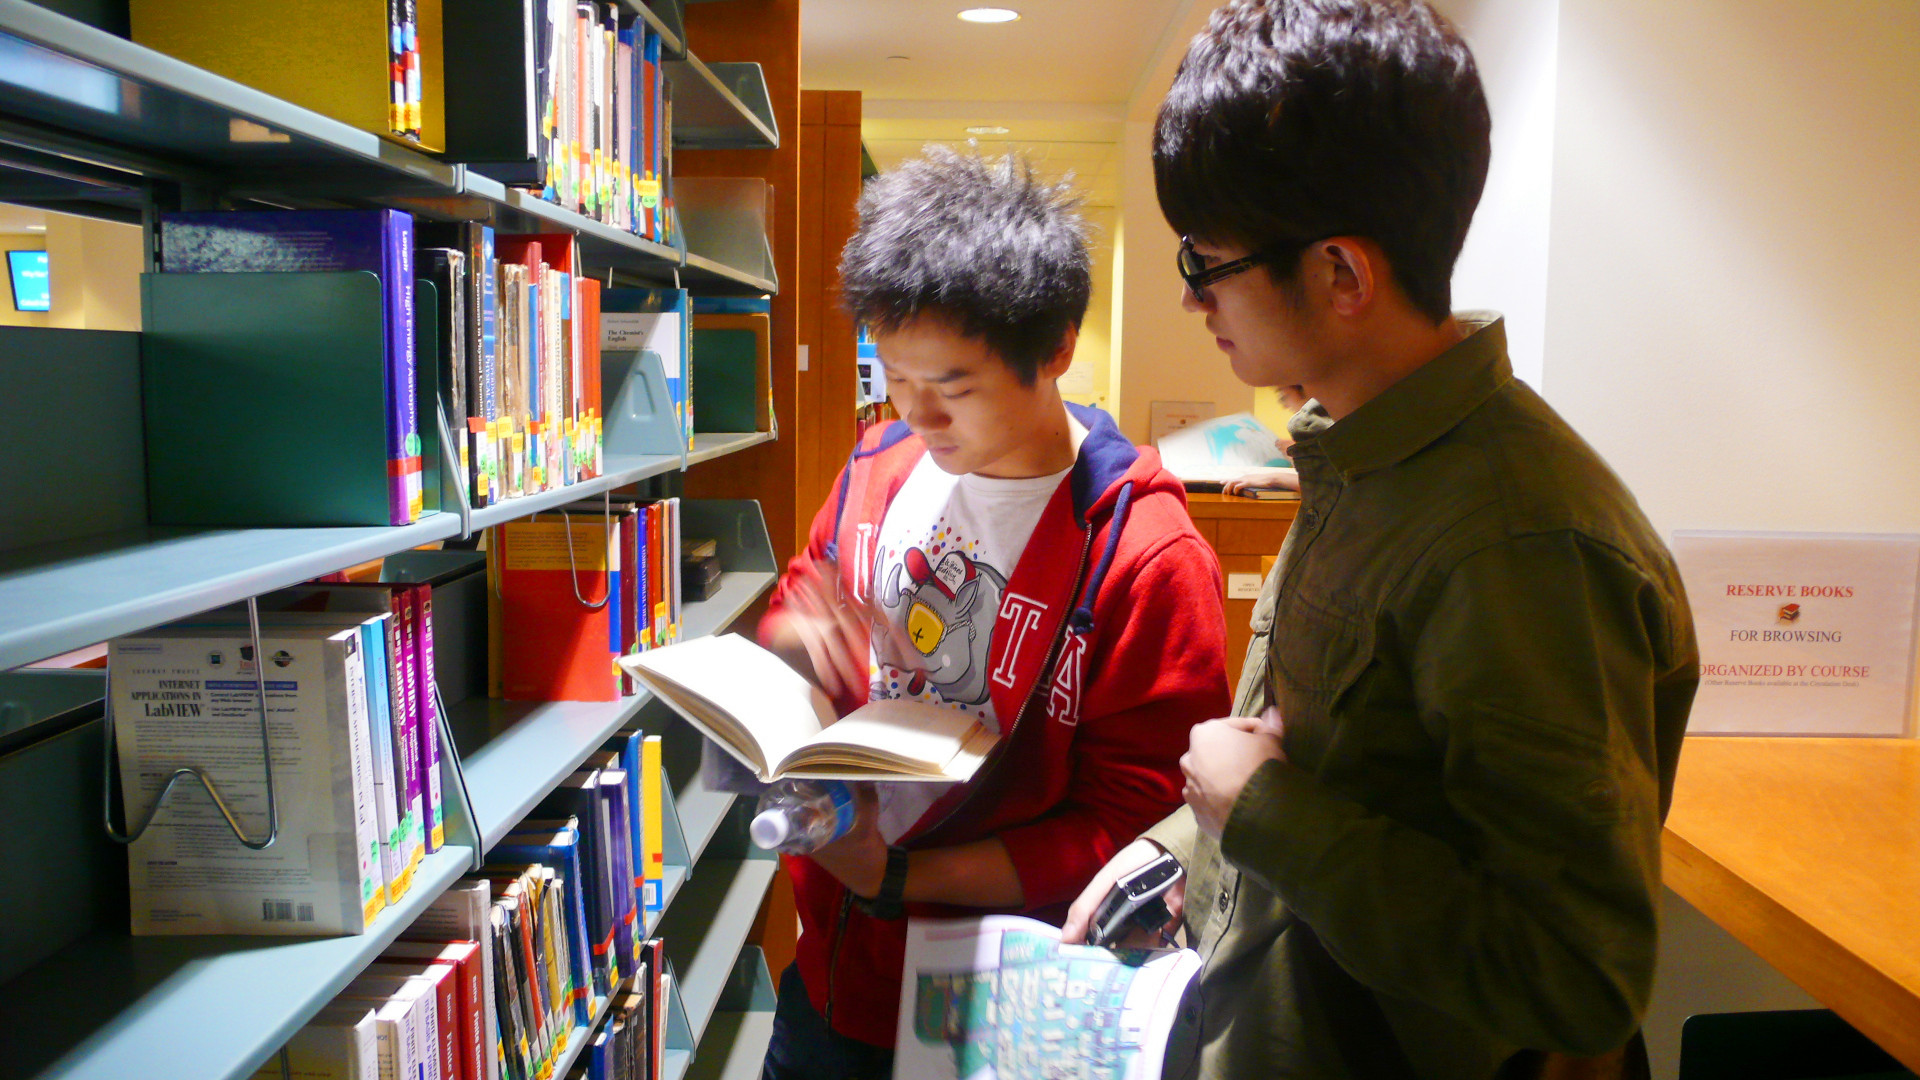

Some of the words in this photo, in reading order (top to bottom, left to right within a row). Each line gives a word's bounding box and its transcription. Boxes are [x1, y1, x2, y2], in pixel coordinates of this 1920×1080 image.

[405, 316, 413, 364] Energy
[1726, 584, 1796, 598] RESERVE
[1800, 585, 1854, 598] BOOKS
[1730, 629, 1758, 642] FOR
[1762, 630, 1842, 643] BROWSING
[159, 680, 200, 689] INTERNET
[407, 653, 416, 717] LabVIEW
[425, 646, 437, 709] LabVIEW
[1786, 665, 1807, 677] BY
[1810, 666, 1870, 678] COURSE
[131, 692, 190, 701] APPLICATIONS
[192, 692, 202, 701] IN
[395, 660, 406, 726] LabVIEW
[145, 703, 201, 717] LabVIEW
[349, 666, 357, 717] INTERNET
[353, 719, 362, 787] APPLICATIONS
[446, 1031, 454, 1072] Finite
